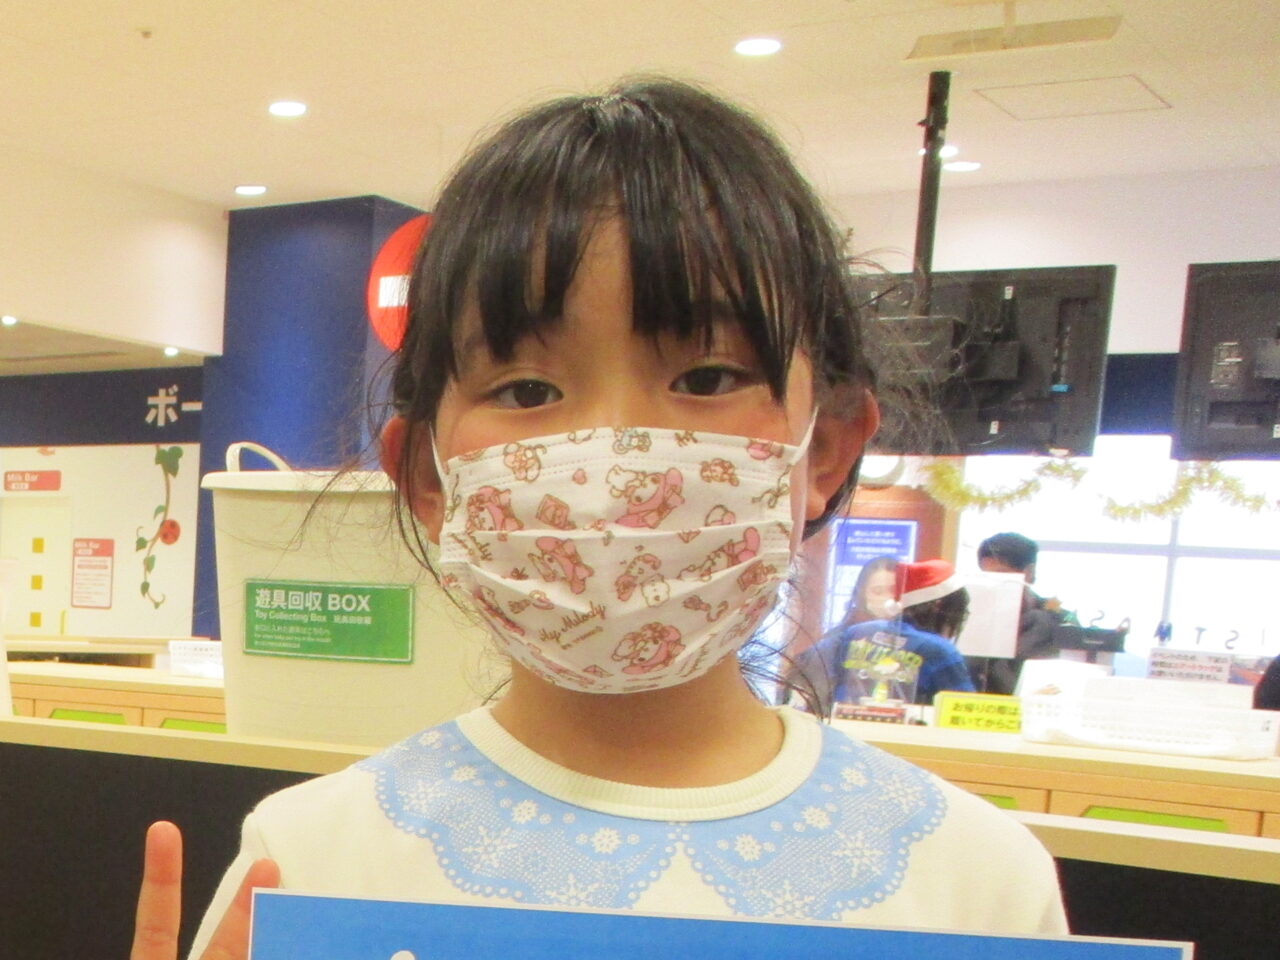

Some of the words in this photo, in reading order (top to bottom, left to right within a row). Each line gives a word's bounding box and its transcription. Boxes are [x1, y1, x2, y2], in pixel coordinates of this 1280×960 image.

[145, 384, 203, 427] ボー
[255, 588, 322, 612] 遊具回収
[327, 594, 372, 612] BOX
